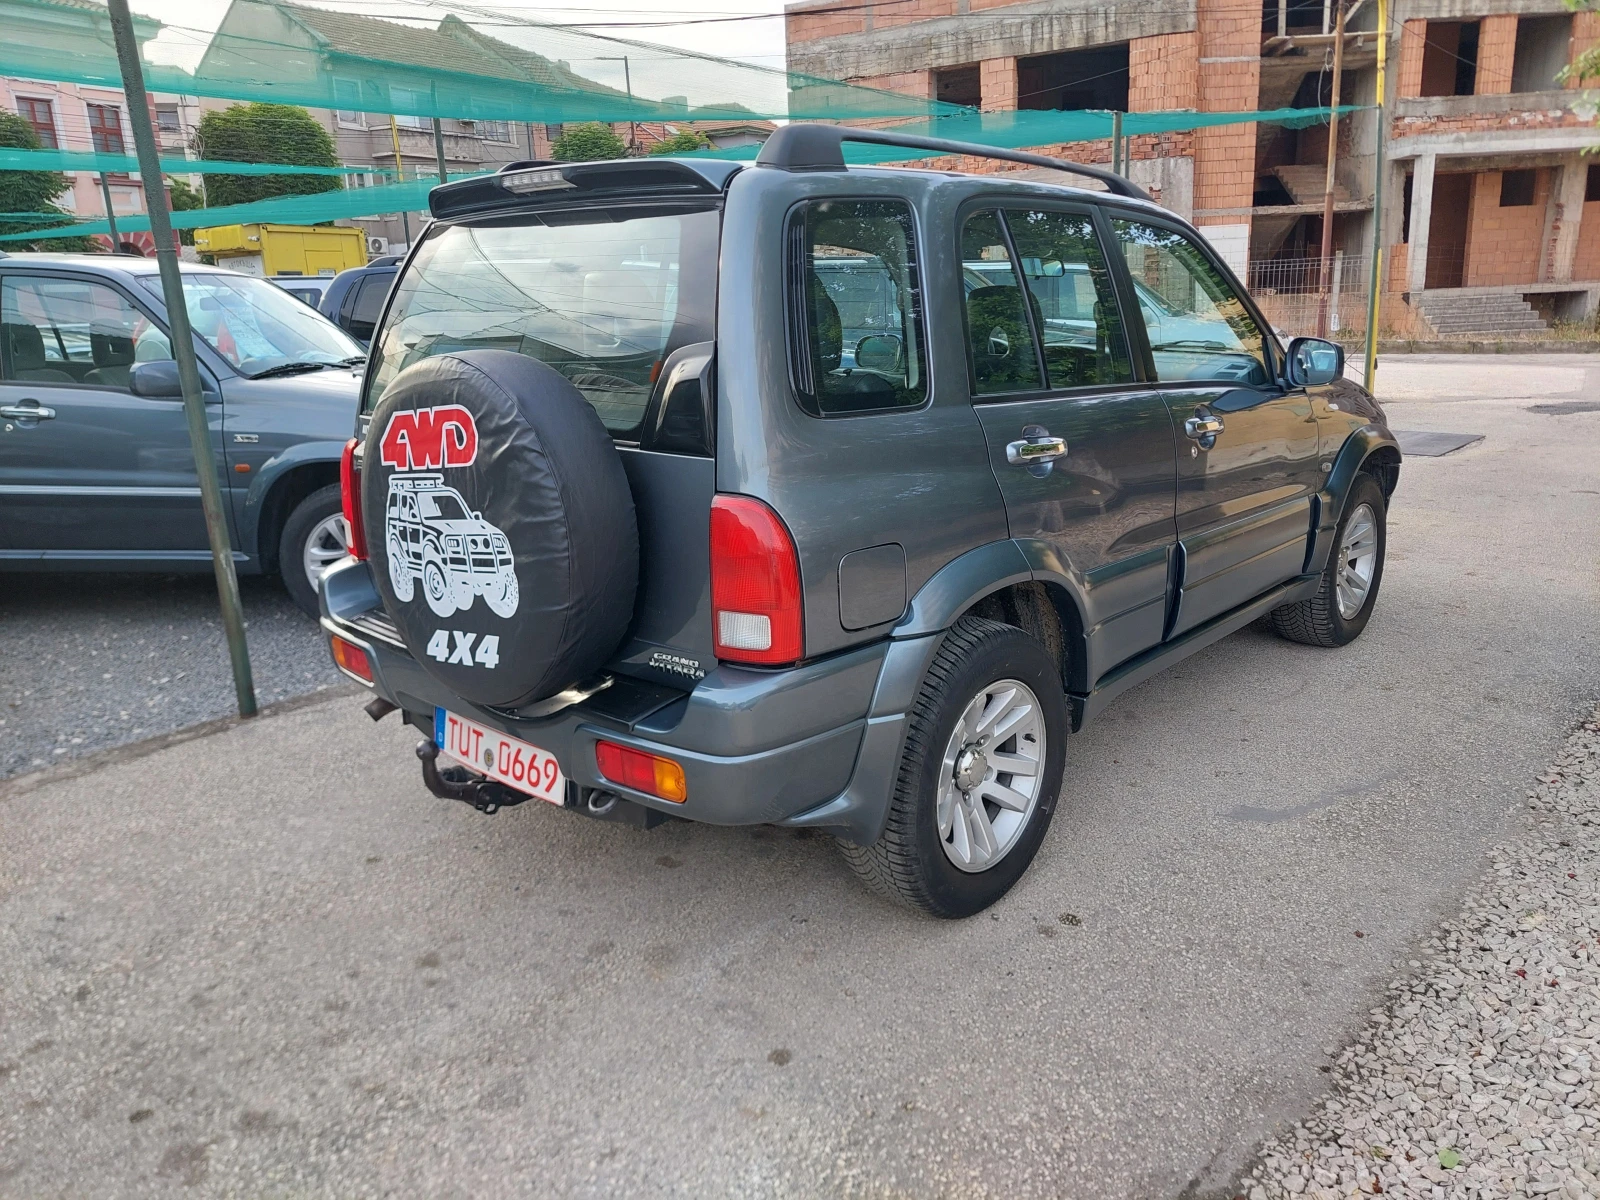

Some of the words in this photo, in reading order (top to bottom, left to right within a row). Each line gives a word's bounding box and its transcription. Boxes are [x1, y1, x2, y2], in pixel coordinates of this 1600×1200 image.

[379, 404, 478, 471] 4WD
[426, 629, 499, 669] 4X4
[653, 652, 699, 668] GRAND
[448, 716, 484, 763] TUT
